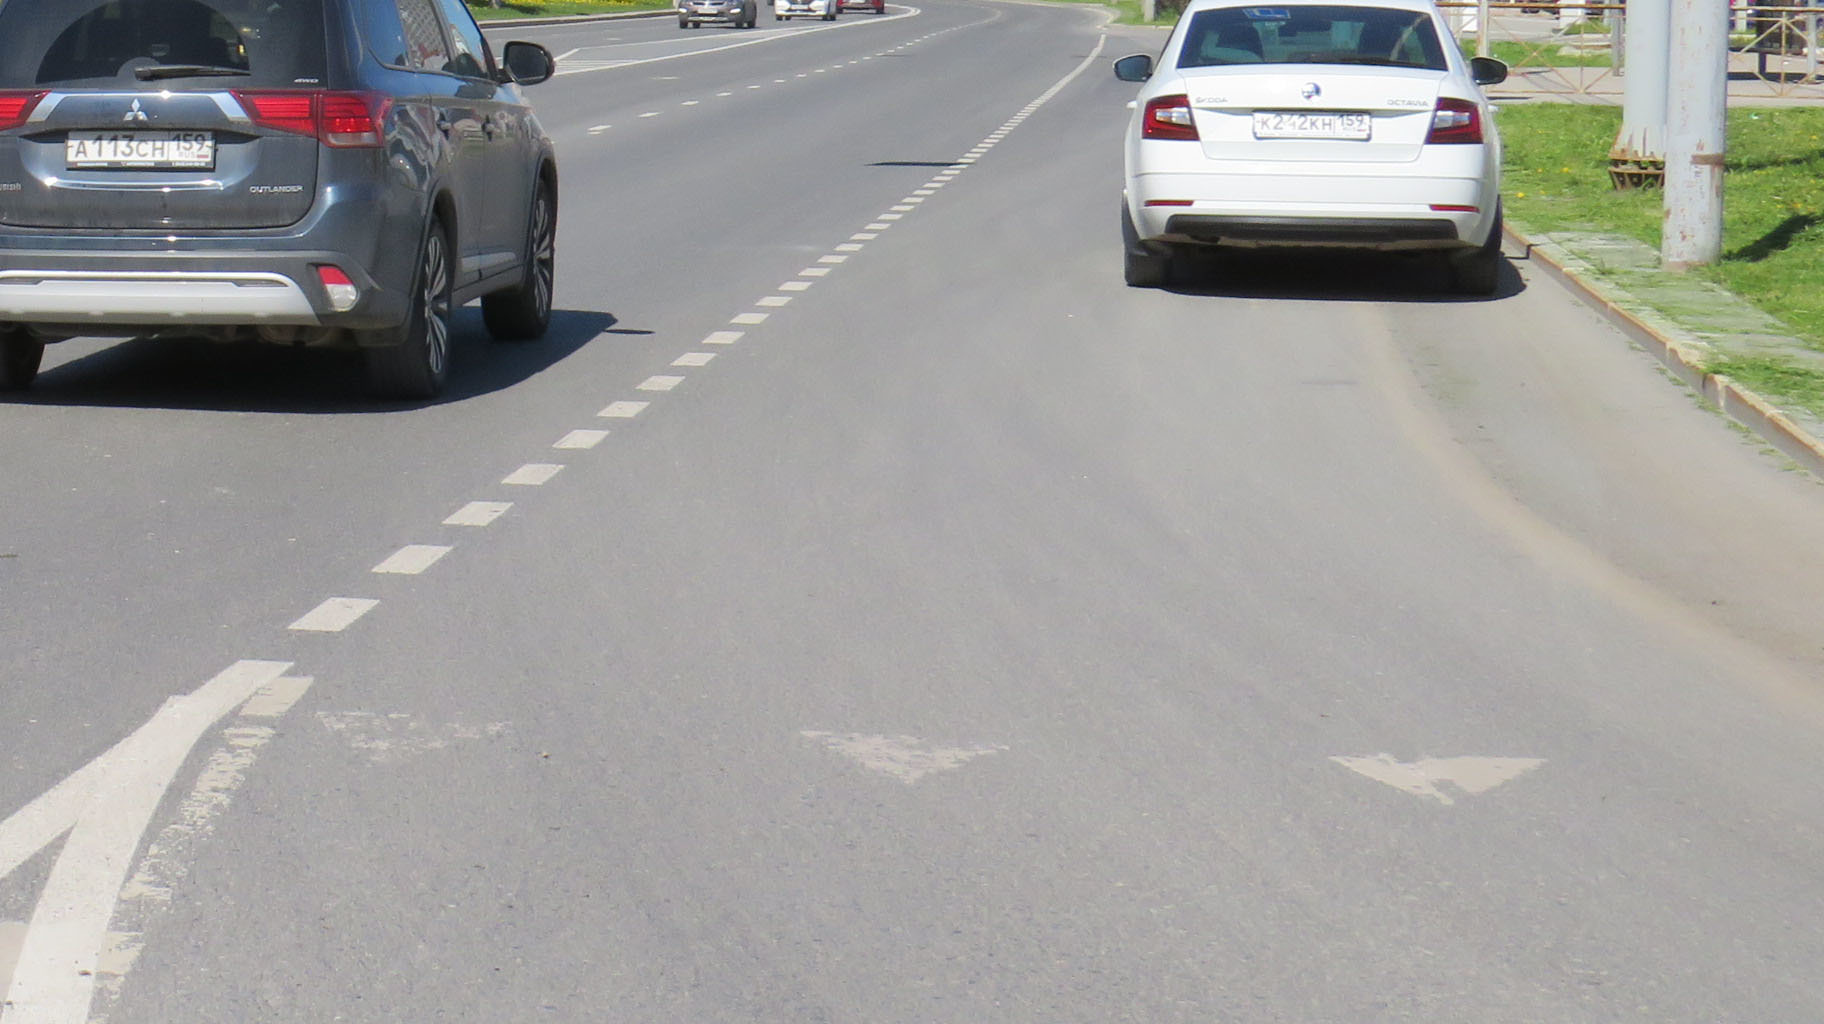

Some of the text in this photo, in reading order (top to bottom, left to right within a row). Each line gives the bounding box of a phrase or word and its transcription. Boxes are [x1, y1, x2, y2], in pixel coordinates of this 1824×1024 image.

[74, 133, 206, 158] А113СН 159
[249, 184, 304, 193] OUTLANDER
